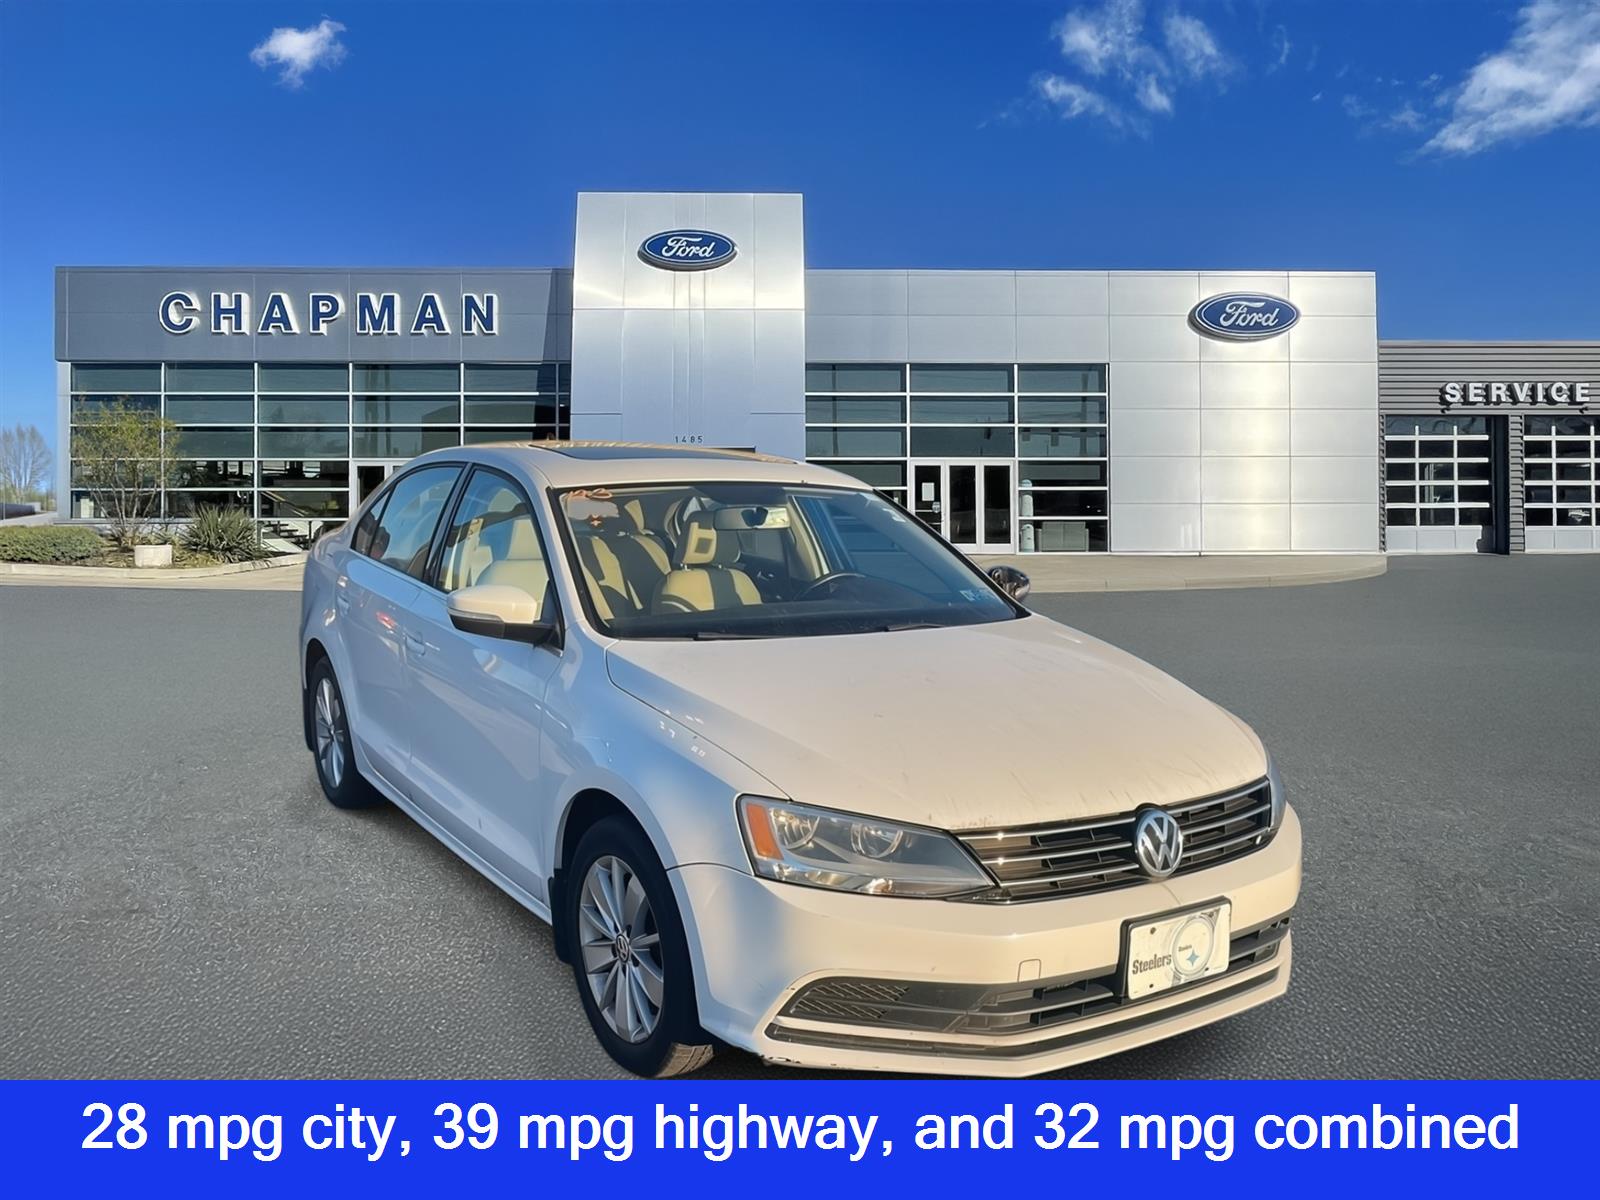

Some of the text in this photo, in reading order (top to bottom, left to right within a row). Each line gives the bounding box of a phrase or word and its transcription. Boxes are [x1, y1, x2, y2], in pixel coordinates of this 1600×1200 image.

[661, 236, 716, 257] Ford
[159, 291, 498, 335] CHAPMAN
[1220, 301, 1280, 326] Ford
[1444, 382, 1590, 403] SERVICE
[675, 435, 703, 444] 1485
[1132, 953, 1172, 975] Steelers
